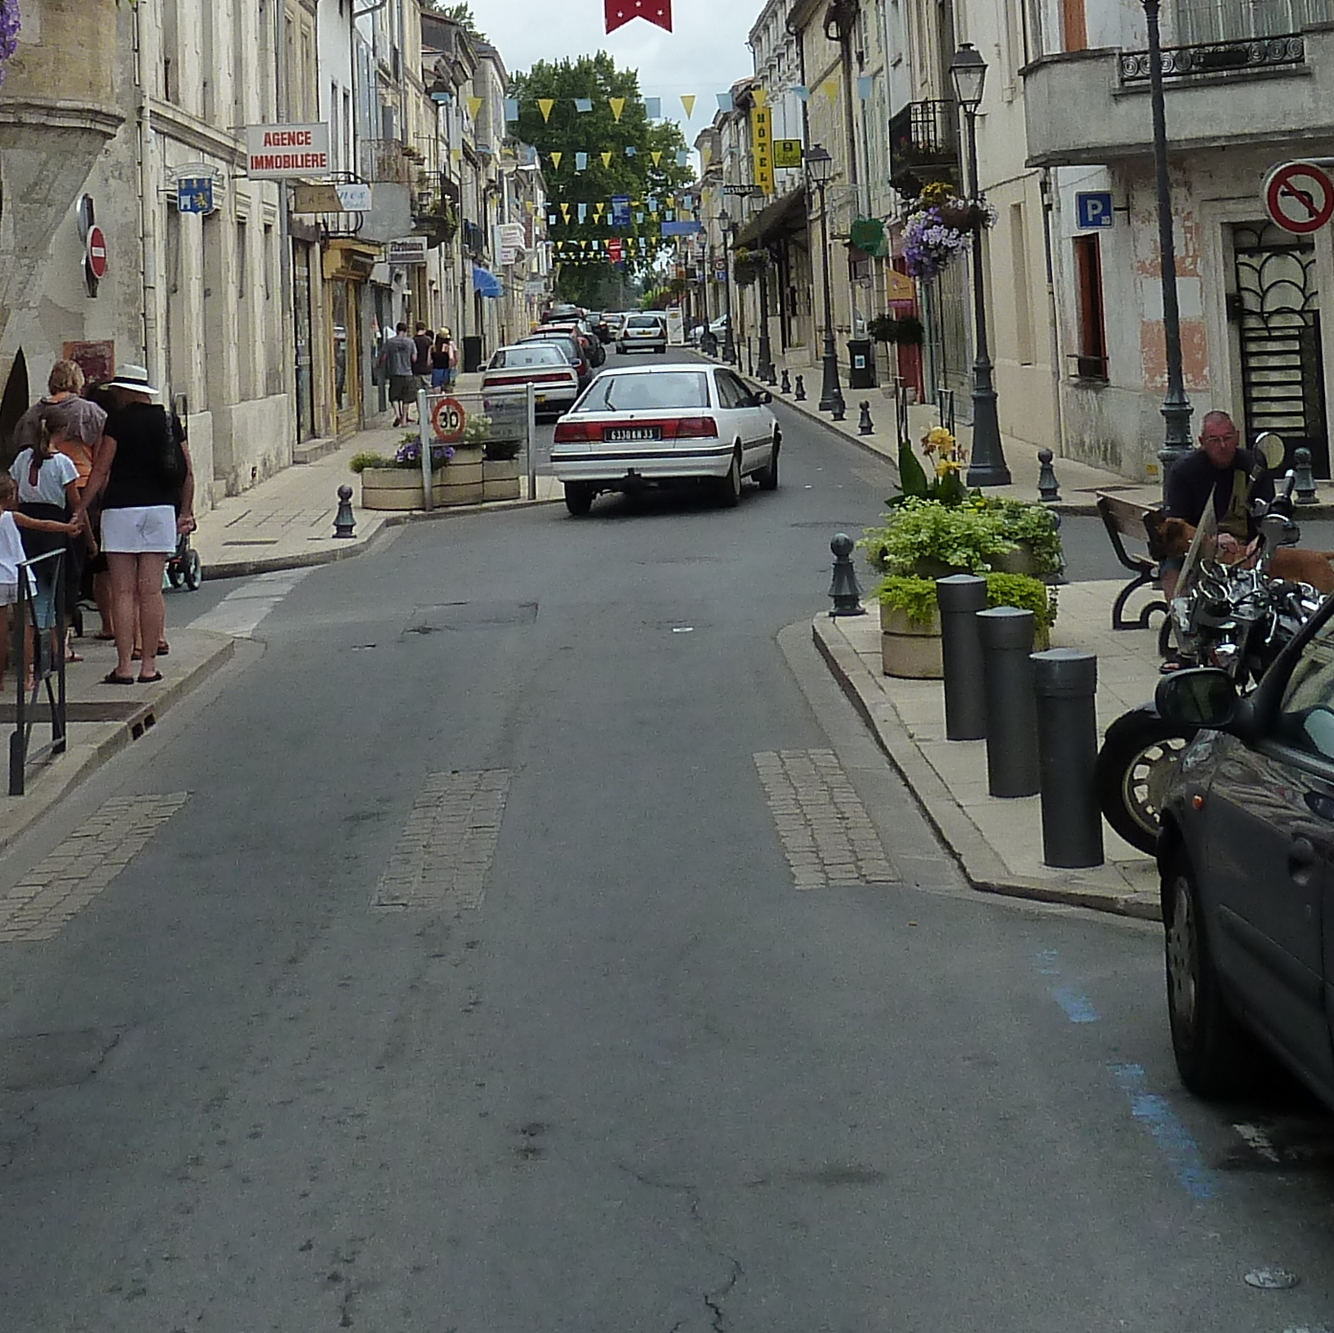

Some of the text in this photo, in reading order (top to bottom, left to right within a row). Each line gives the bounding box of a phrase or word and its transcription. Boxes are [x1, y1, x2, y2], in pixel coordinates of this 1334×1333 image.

[264, 131, 312, 147] AGENCE
[250, 153, 327, 170] IMMOBILIÈRE
[1087, 199, 1104, 222] P
[440, 411, 459, 429] 30
